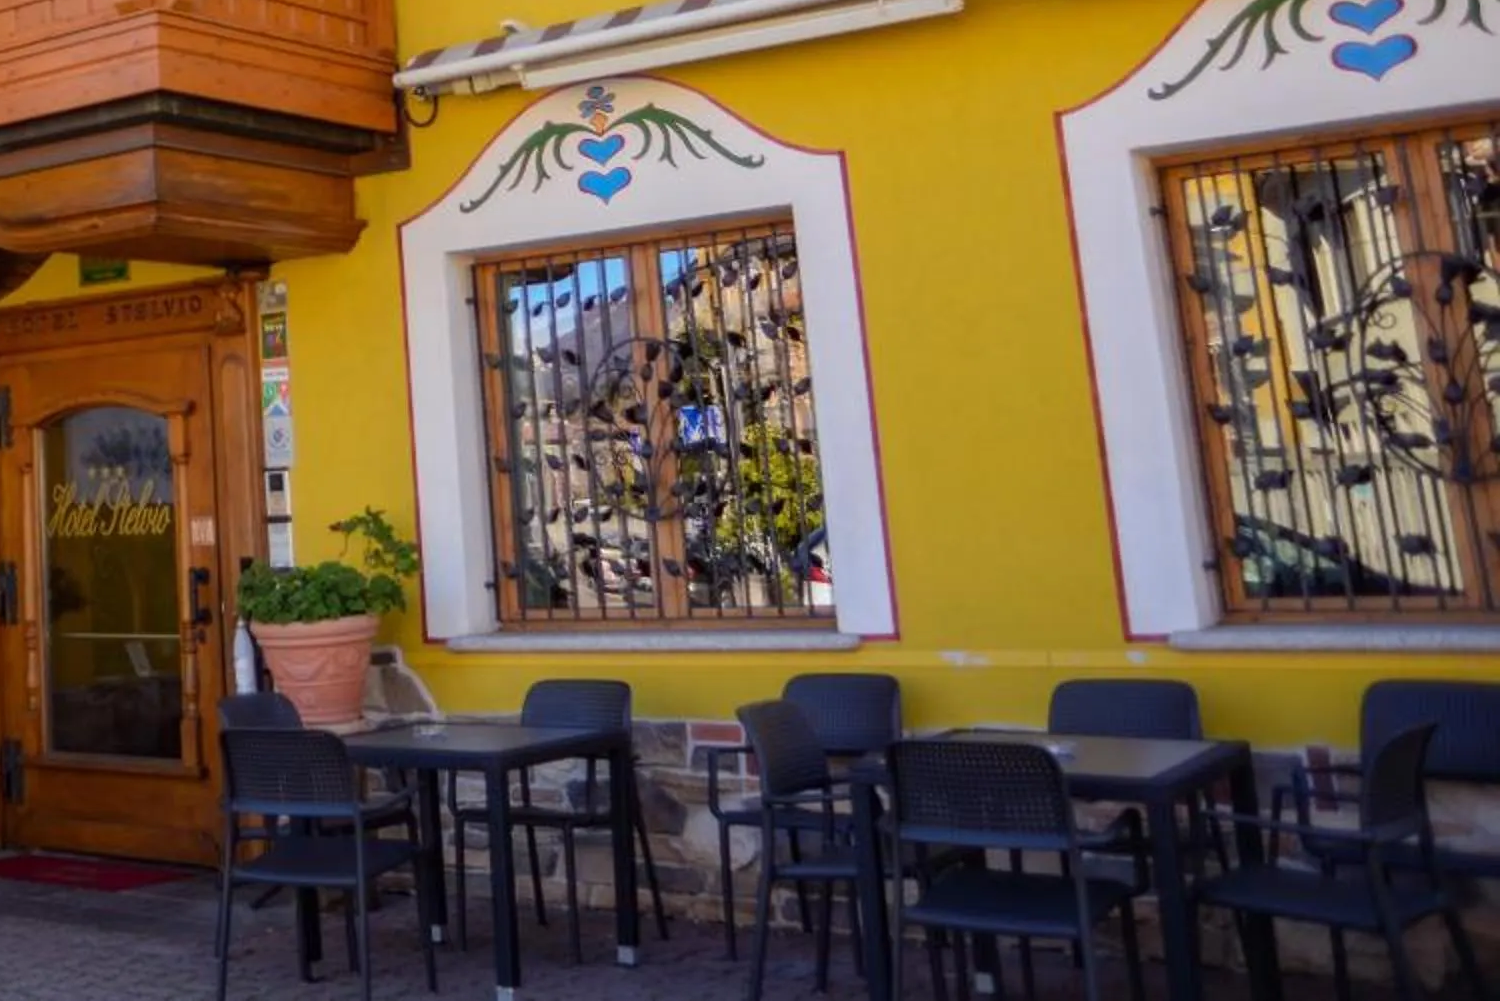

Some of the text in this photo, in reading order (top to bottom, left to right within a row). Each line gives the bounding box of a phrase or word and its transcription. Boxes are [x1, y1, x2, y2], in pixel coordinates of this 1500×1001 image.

[104, 295, 202, 325] STELVIO
[47, 475, 172, 538] Hotel Stelvio
